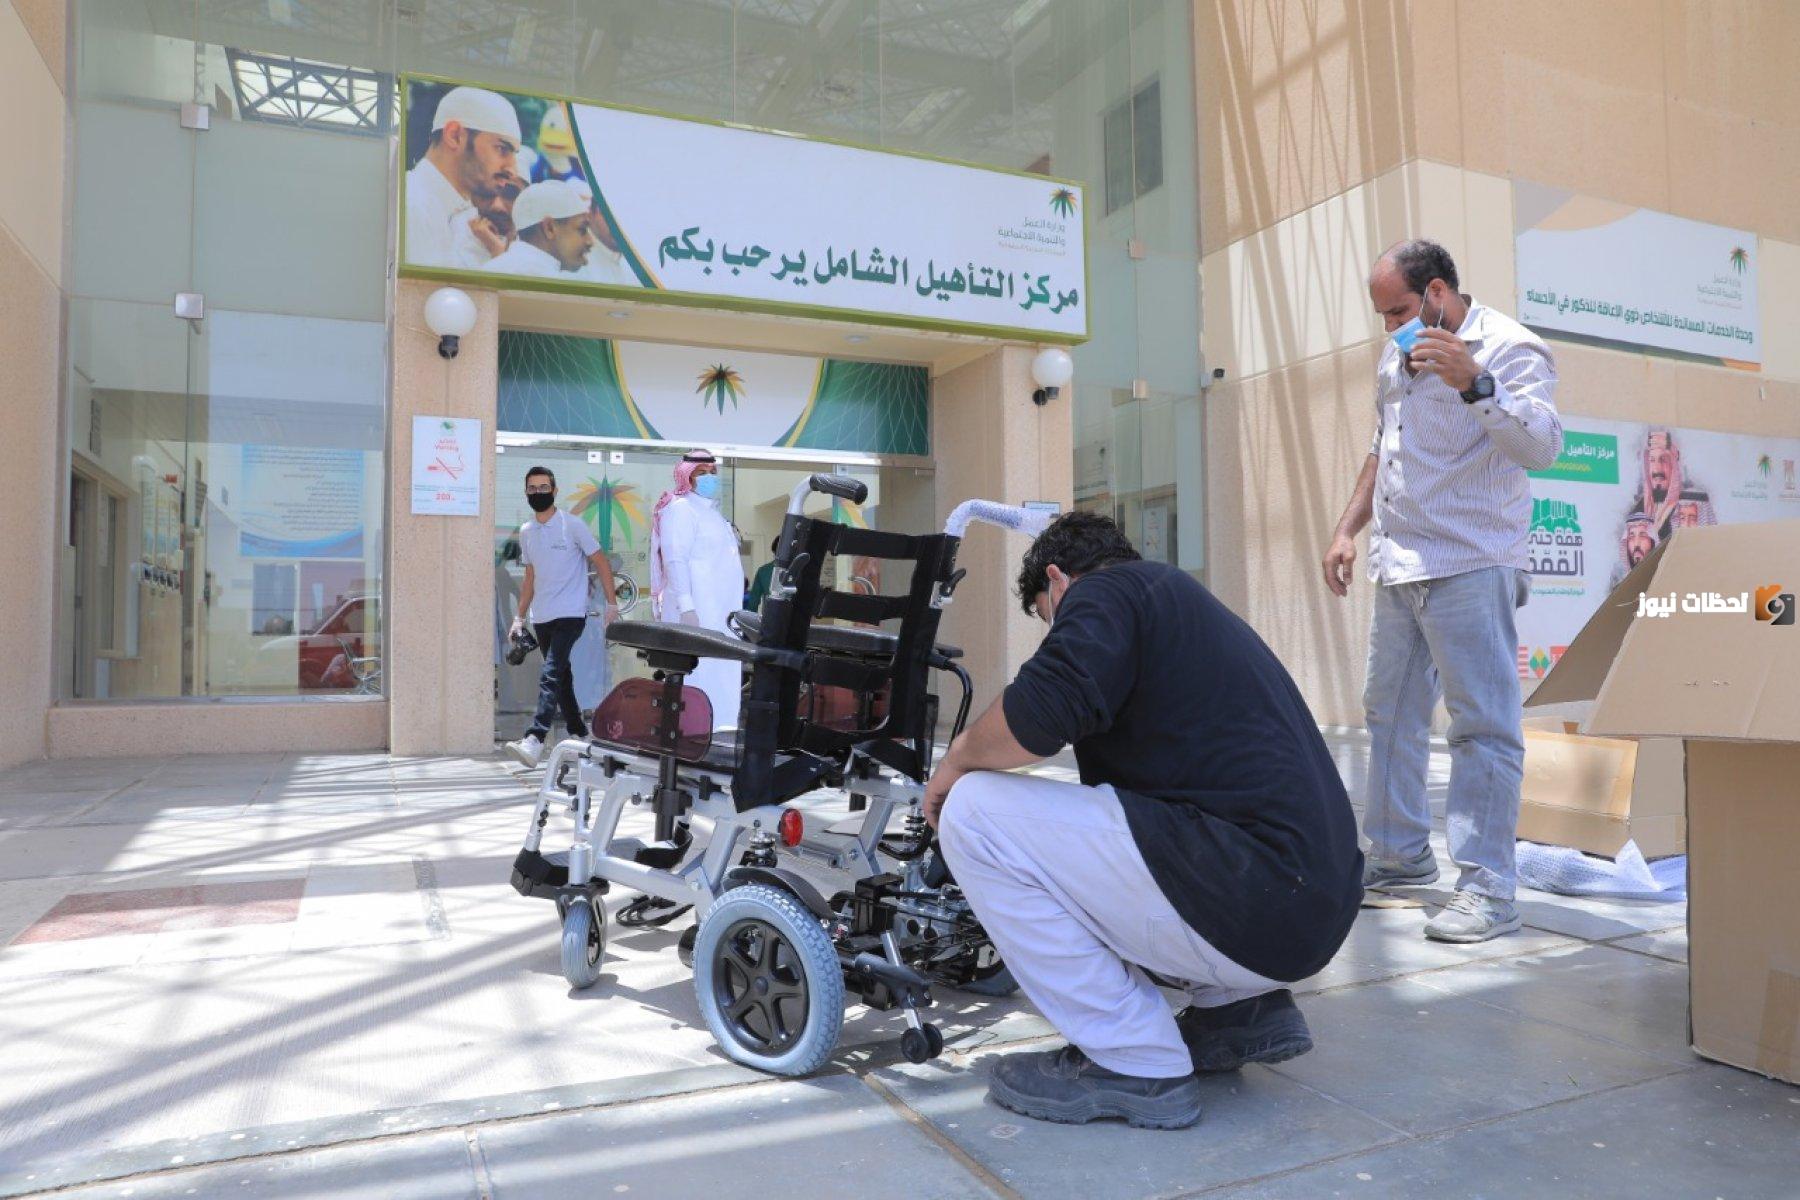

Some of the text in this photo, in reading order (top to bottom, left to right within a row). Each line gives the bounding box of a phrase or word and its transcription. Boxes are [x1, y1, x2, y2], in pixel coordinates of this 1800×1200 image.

[659, 226, 1079, 314] مركز التأهيل الشامل يرحب بكم
